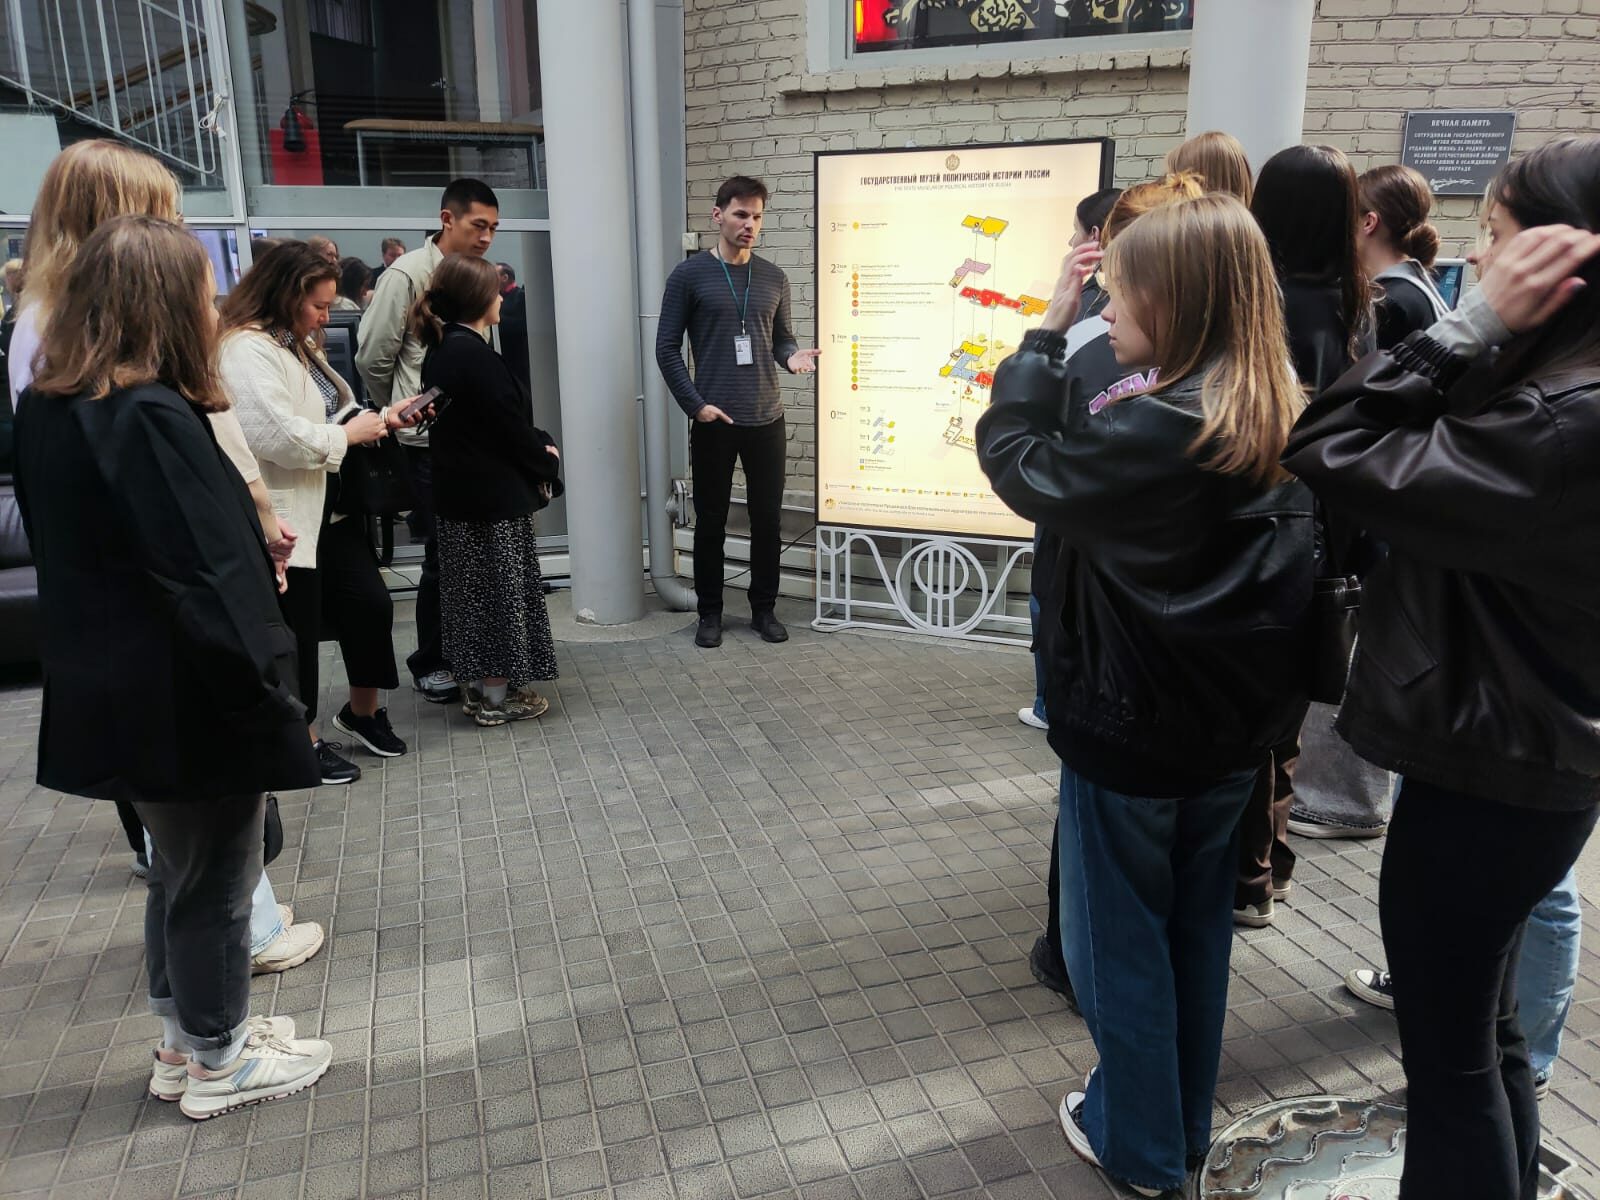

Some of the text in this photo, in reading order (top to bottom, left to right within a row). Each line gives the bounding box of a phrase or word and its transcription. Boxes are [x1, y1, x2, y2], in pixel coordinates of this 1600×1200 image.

[1431, 119, 1491, 127] ВЕЧНАЯ ПАМЯТЬ
[860, 169, 1051, 186] ГОСУДАРСТВЕННЫЙ МУЗЕЙ ПОЛИТИЧЕСКОЙ ИСТОРИИ РОССИИ
[830, 222, 837, 232] 3
[830, 263, 837, 274] 2
[831, 334, 835, 344] 1
[830, 410, 837, 421] 0
